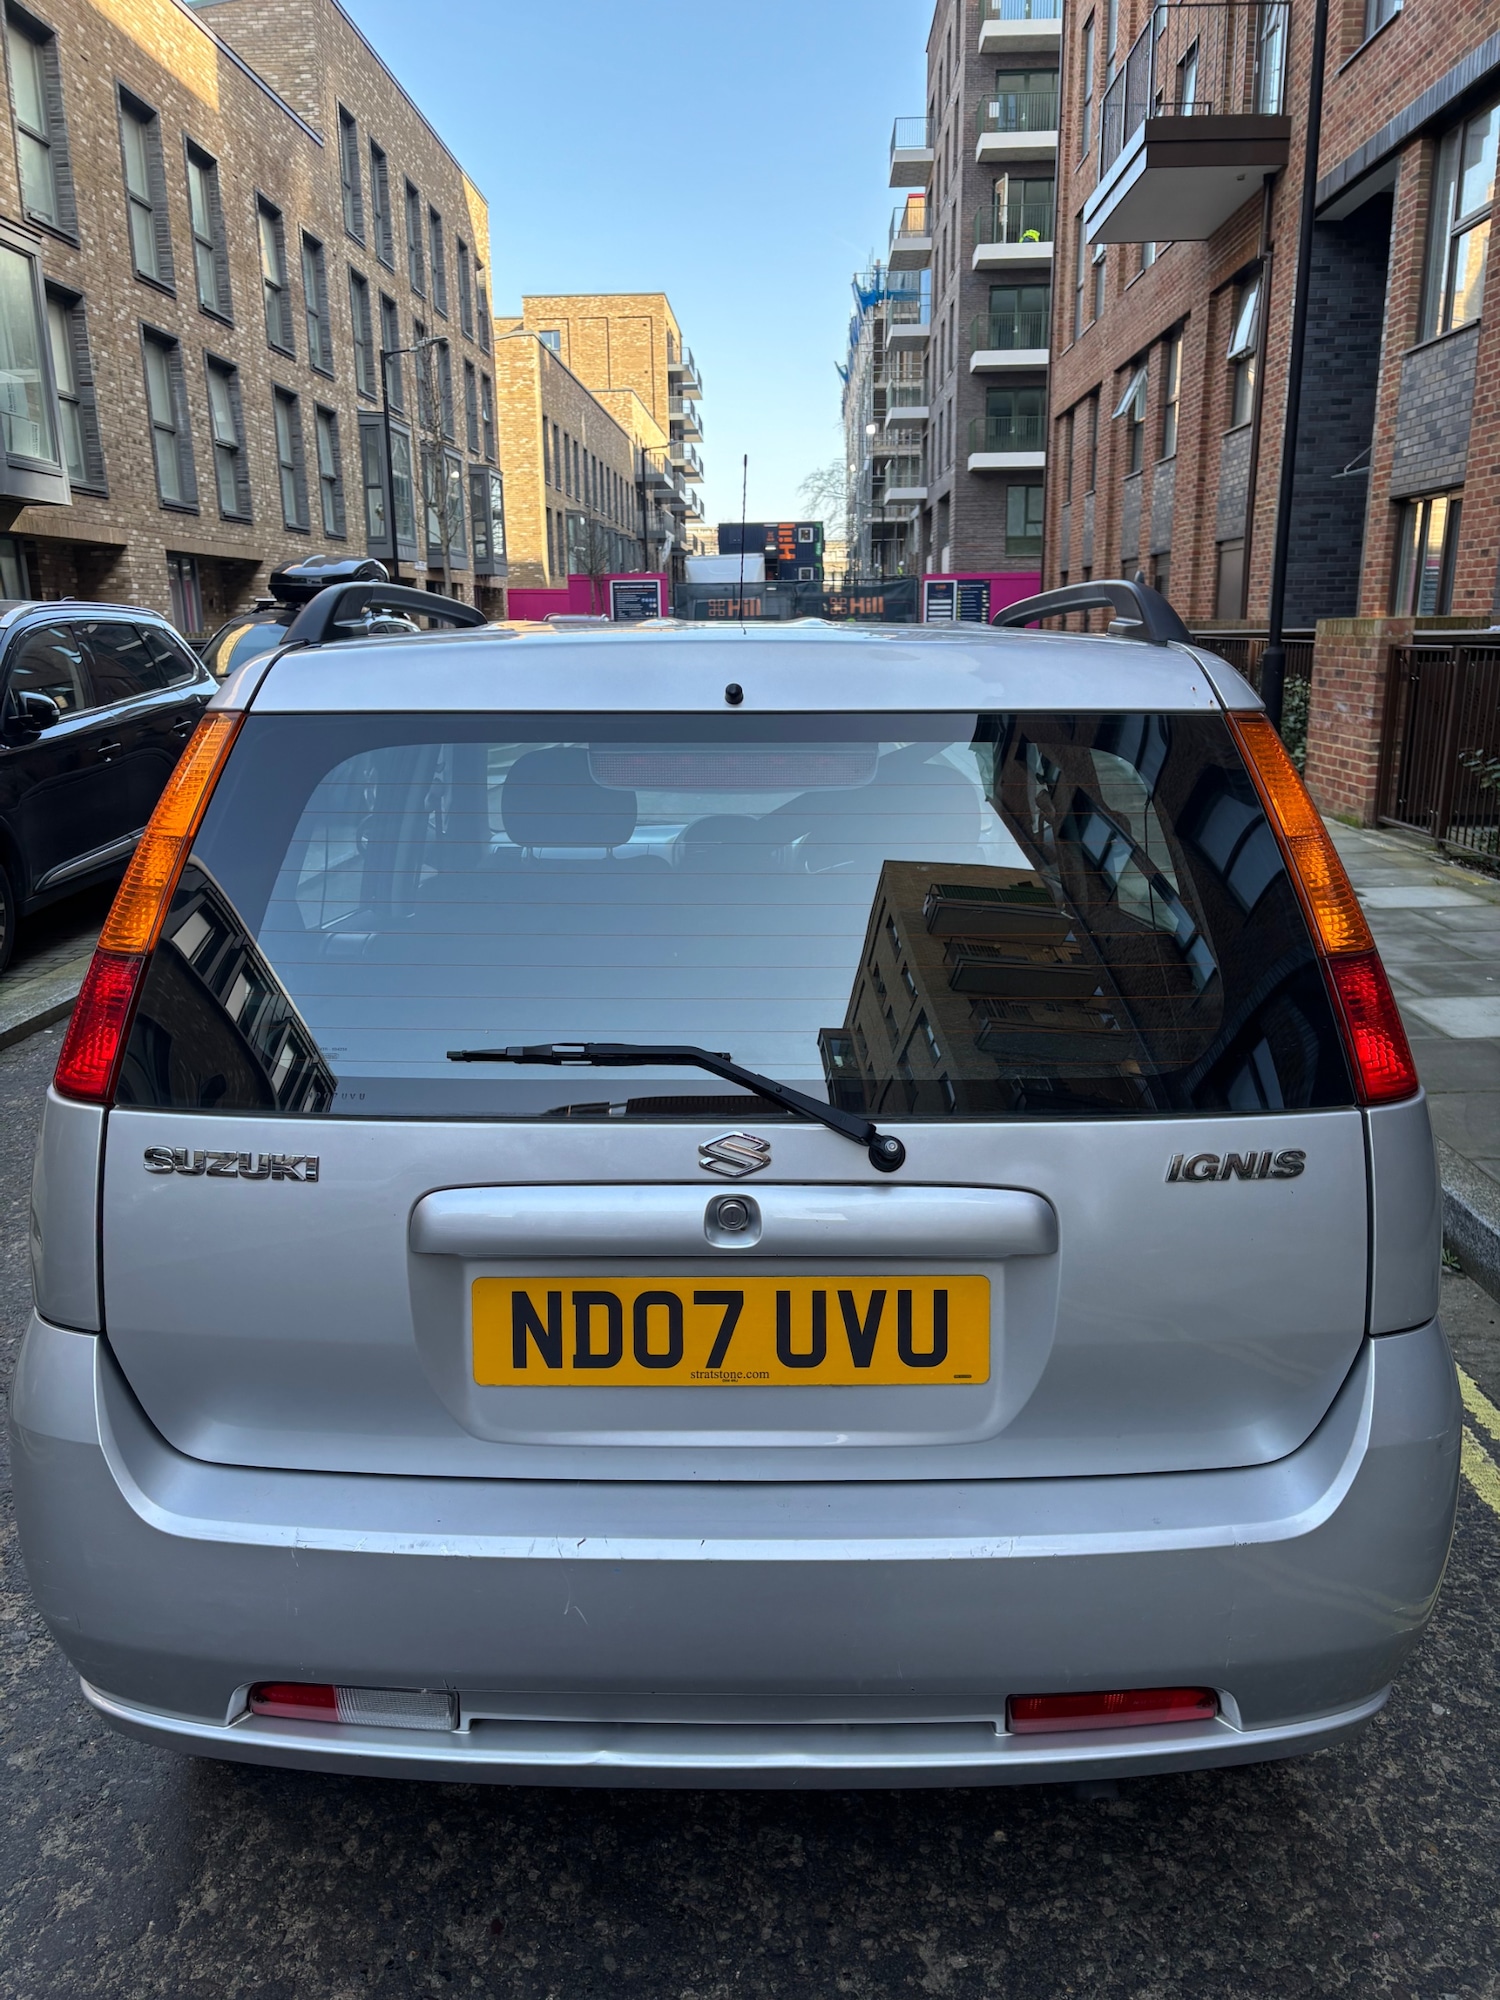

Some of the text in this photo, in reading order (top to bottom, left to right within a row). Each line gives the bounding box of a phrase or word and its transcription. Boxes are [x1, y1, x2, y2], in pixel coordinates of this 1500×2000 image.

[778, 524, 796, 560] Hill
[728, 598, 761, 616] Hill
[850, 597, 884, 614] Hill
[143, 1145, 320, 1183] SUZUKI
[1165, 1147, 1307, 1183] IGNIS
[511, 1289, 949, 1369] ND07 UVU
[690, 1370, 770, 1379] stratstone.com
